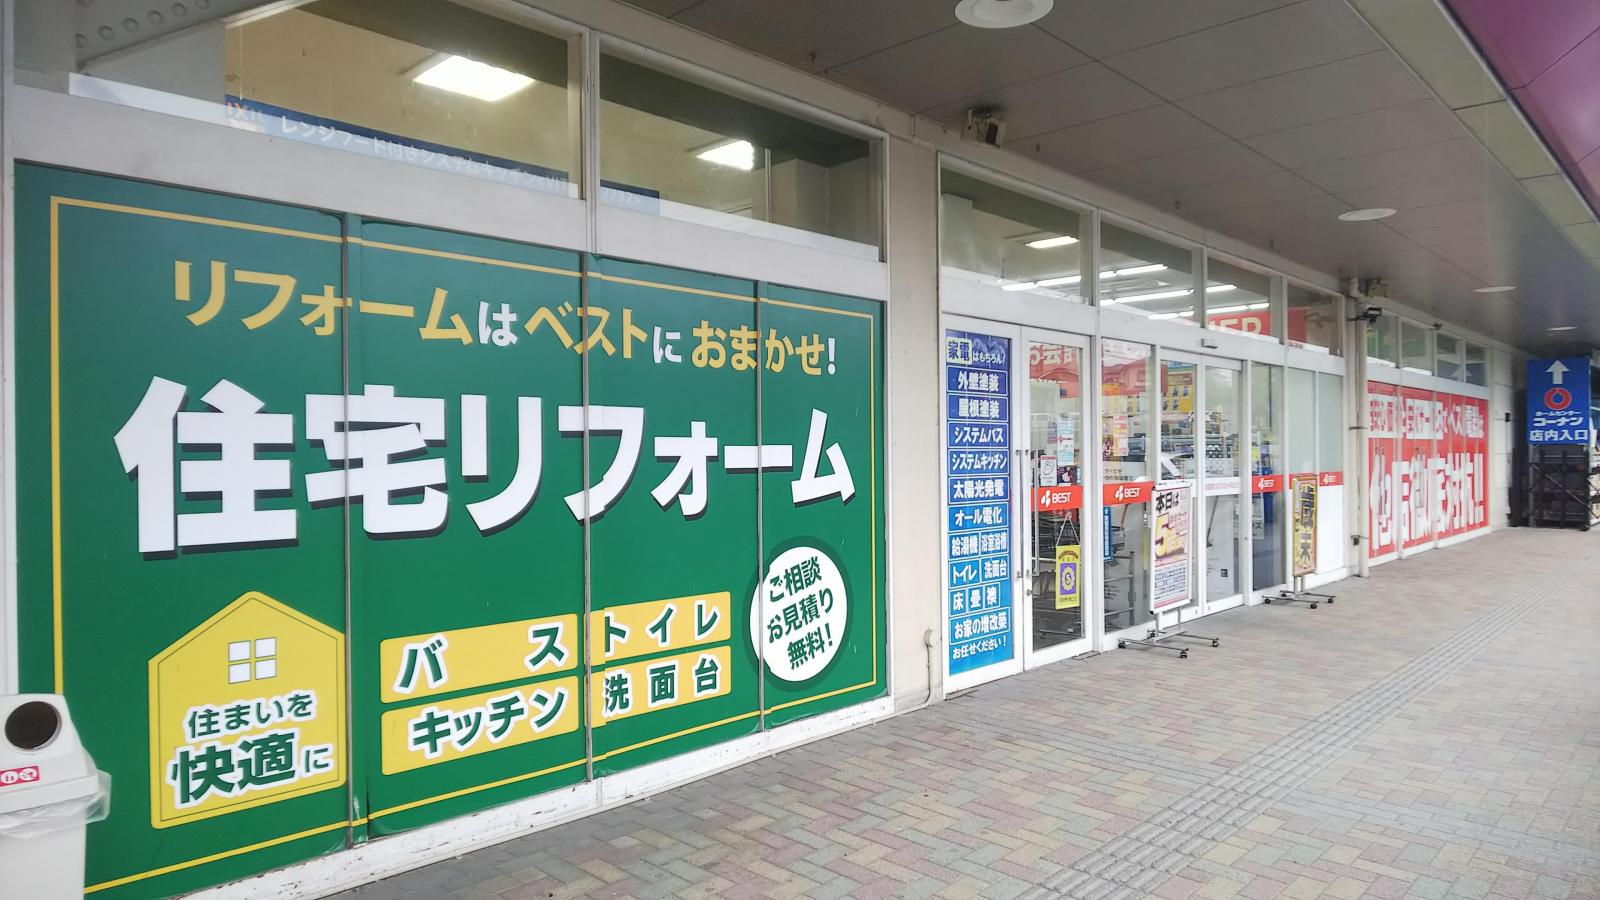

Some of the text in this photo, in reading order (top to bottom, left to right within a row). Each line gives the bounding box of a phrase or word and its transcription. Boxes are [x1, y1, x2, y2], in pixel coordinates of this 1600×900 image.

[957, 370, 1000, 392] 外壁塗装
[1533, 416, 1584, 427] コーナン
[954, 426, 1004, 444] システムバス
[1529, 429, 1589, 442] 店内入口
[113, 375, 857, 557] 住宅リフォーム
[952, 453, 1008, 471] システムキッチン
[953, 479, 1005, 499] 太陽光発電
[1051, 492, 1072, 504] BEST
[1124, 487, 1141, 498] BEST
[955, 506, 1003, 527] オール電化
[769, 556, 823, 603] ご相談
[953, 559, 1008, 584] トイレ 洗面台
[953, 591, 964, 611] 床
[767, 587, 834, 644] お見積り
[954, 611, 1008, 640] お家の増改築
[604, 602, 720, 655] トイレ
[787, 622, 834, 671] 無料!
[184, 690, 316, 741] 住まいを
[409, 656, 720, 757] キッチン 洗面台
[168, 728, 332, 806] 快適に
